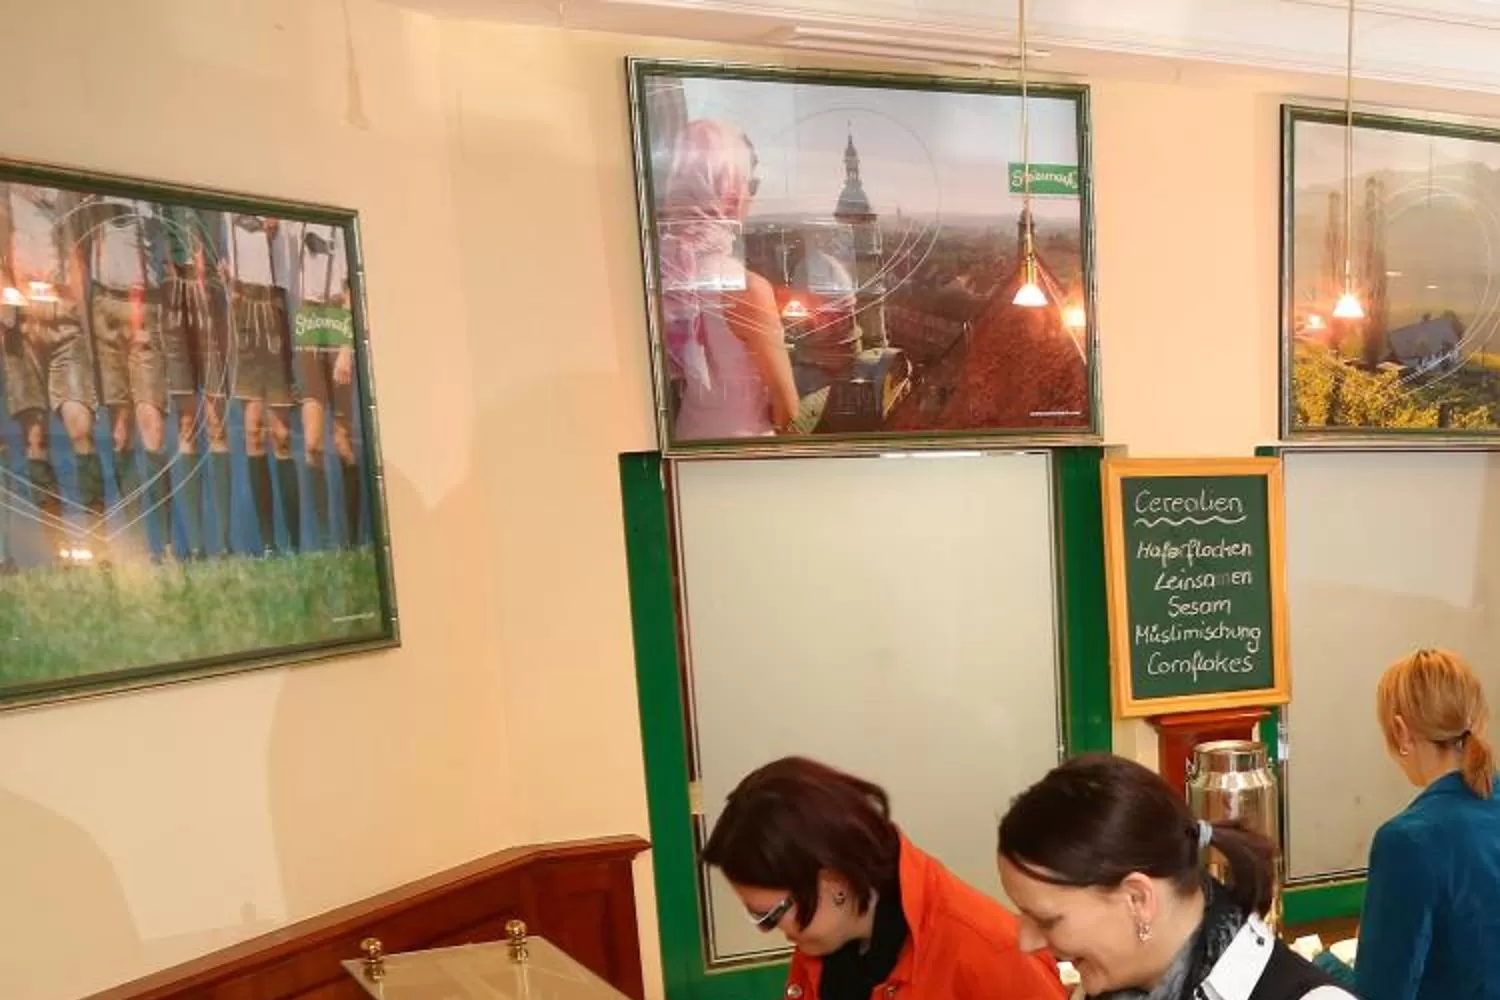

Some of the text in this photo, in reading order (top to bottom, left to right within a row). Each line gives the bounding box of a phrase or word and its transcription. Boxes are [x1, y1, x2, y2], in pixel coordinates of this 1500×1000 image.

[1135, 489, 1243, 514] Cerealien
[1137, 538, 1252, 568] Haferflocken
[1168, 596, 1231, 617] Sesam
[1135, 619, 1261, 653] Müslimischung
[1148, 651, 1253, 683] Cornflakes
